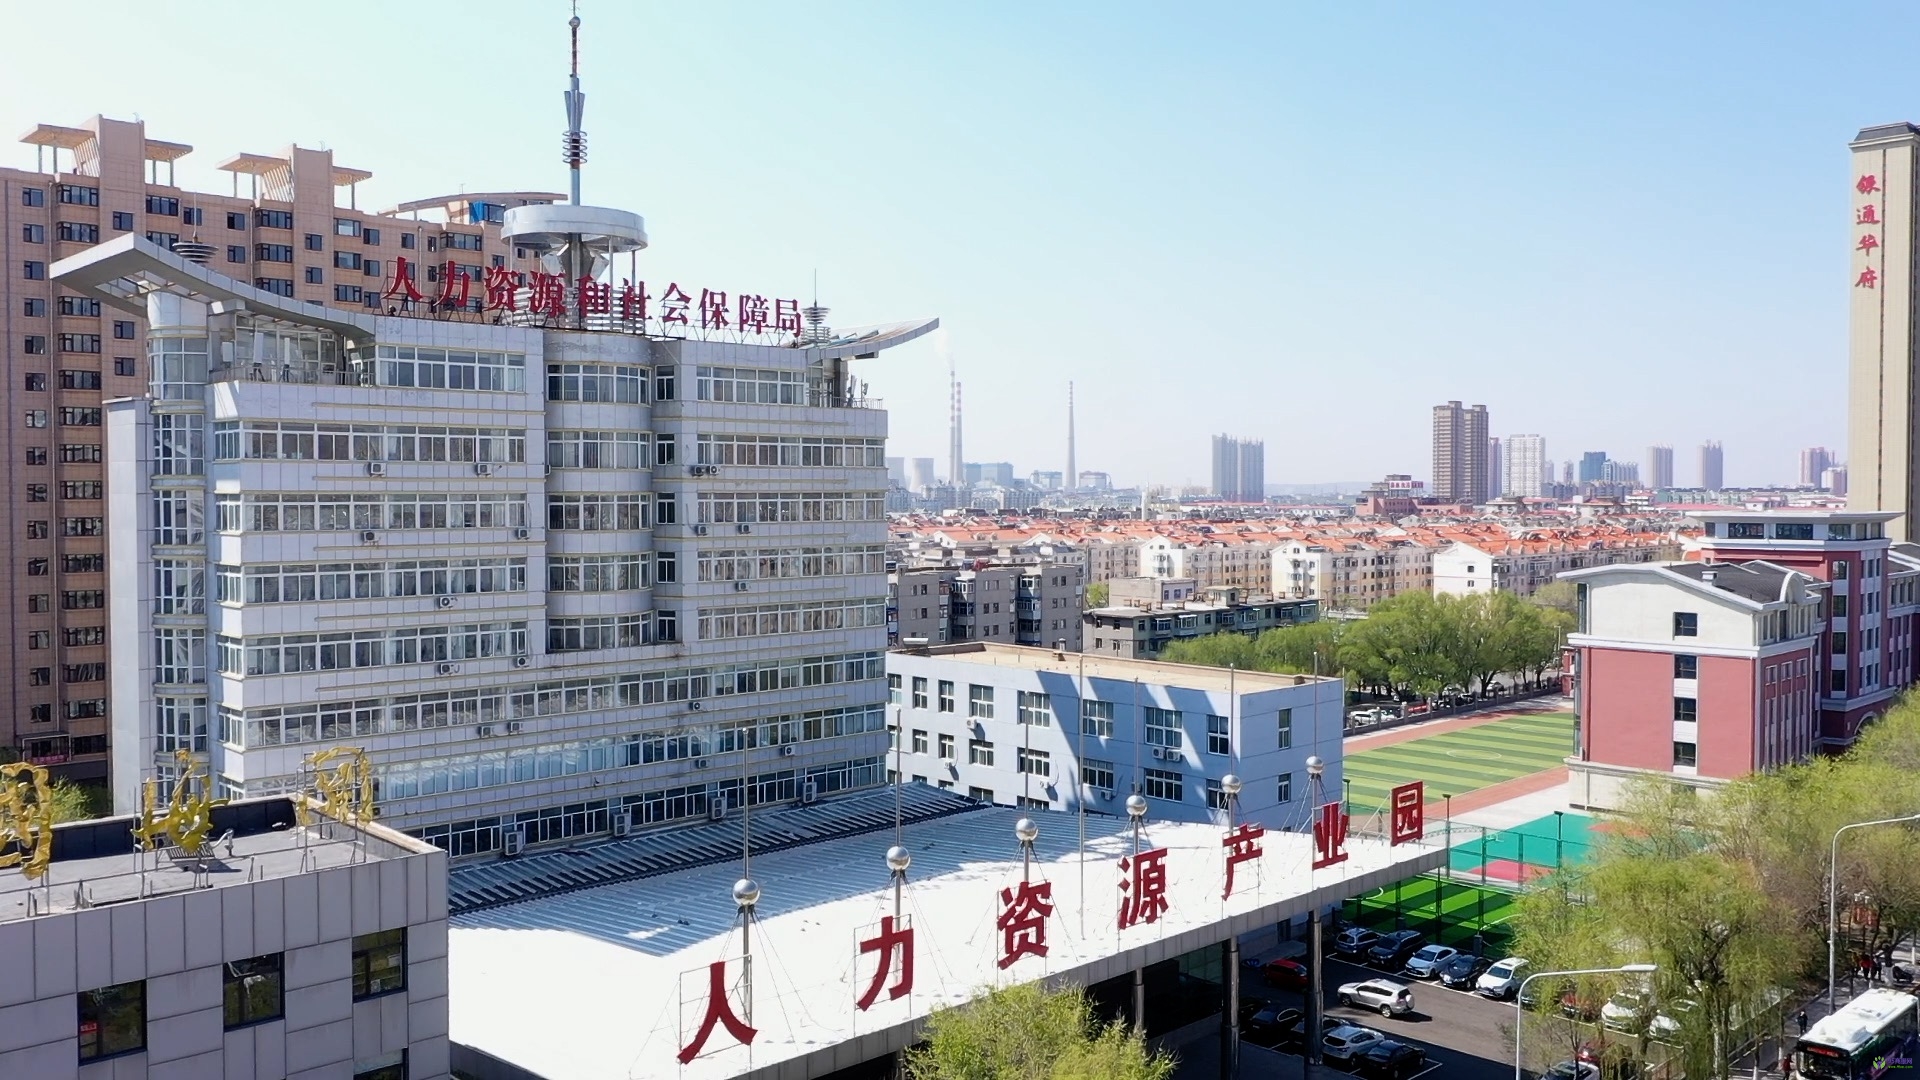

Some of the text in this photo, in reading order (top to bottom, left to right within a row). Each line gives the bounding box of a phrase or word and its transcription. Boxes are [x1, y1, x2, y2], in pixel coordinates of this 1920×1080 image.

[1855, 174, 1881, 290] 银通华府
[383, 255, 802, 338] 人力资源和社会保障局
[677, 780, 1424, 1064] 人力资源产业园
